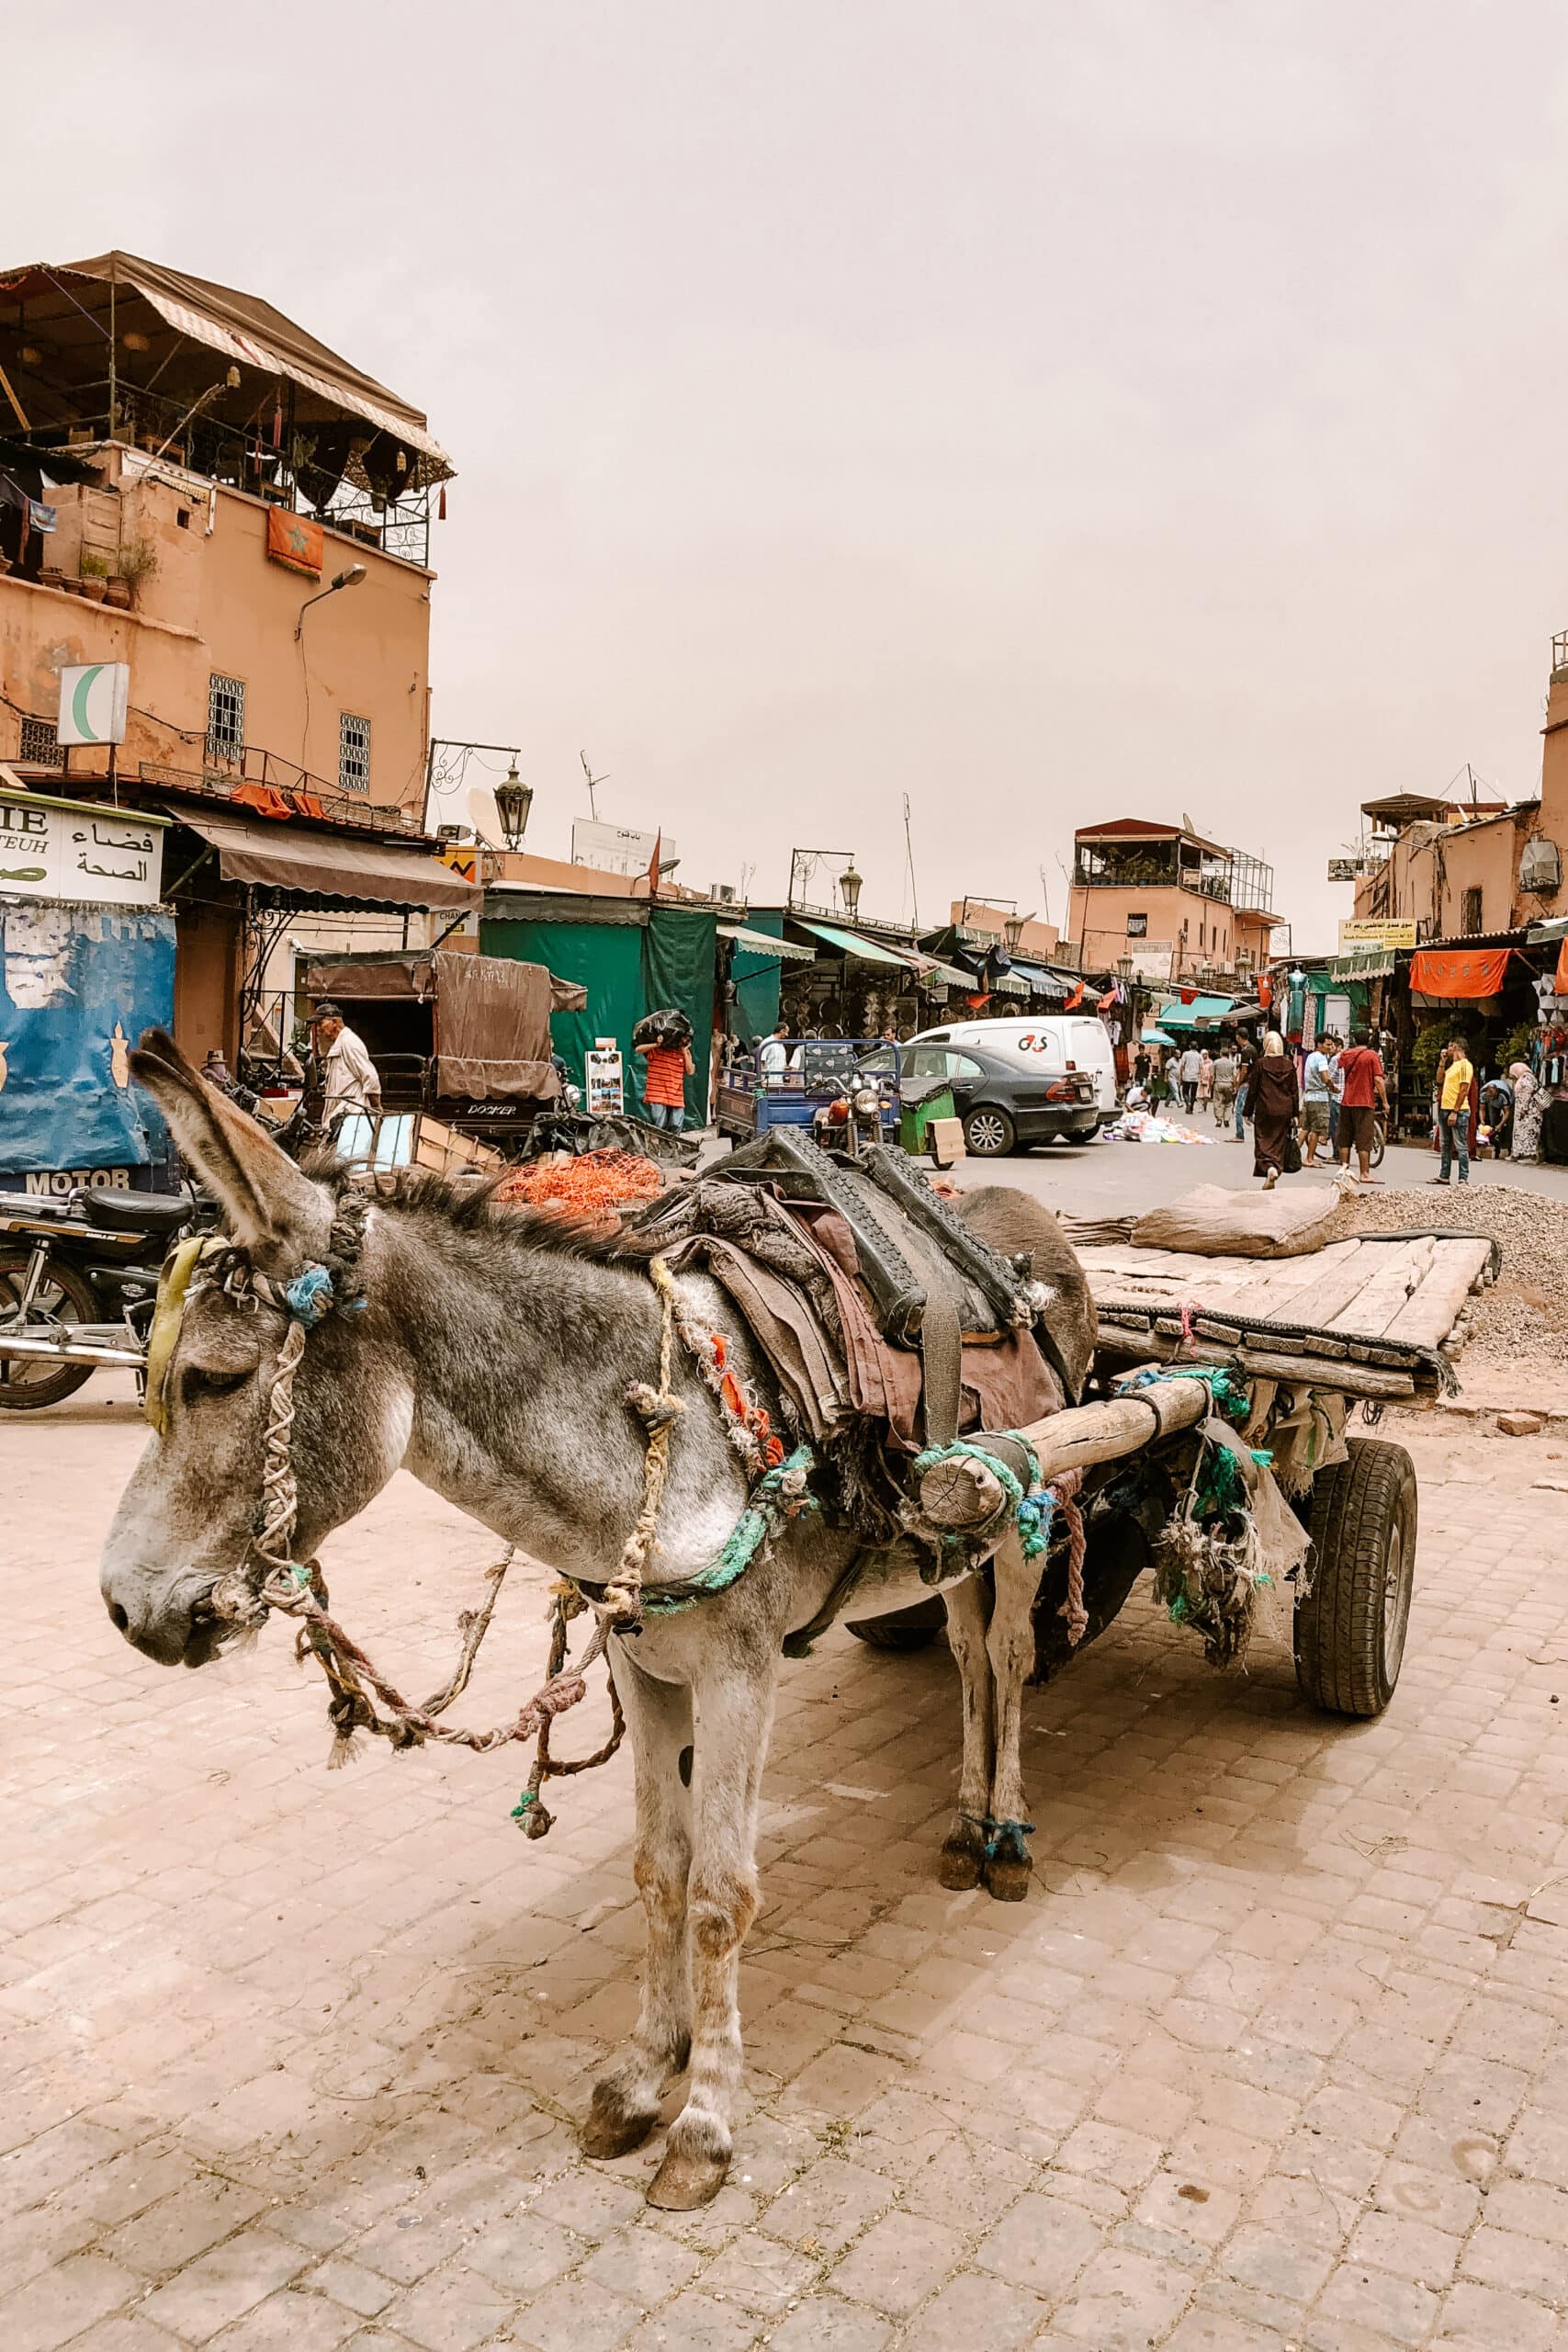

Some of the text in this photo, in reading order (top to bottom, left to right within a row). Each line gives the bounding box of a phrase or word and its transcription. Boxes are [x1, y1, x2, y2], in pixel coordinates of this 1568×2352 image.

[72, 823, 153, 853] فضاء
[76, 853, 147, 882] الصحة
[1018, 1035, 1048, 1053] G4S
